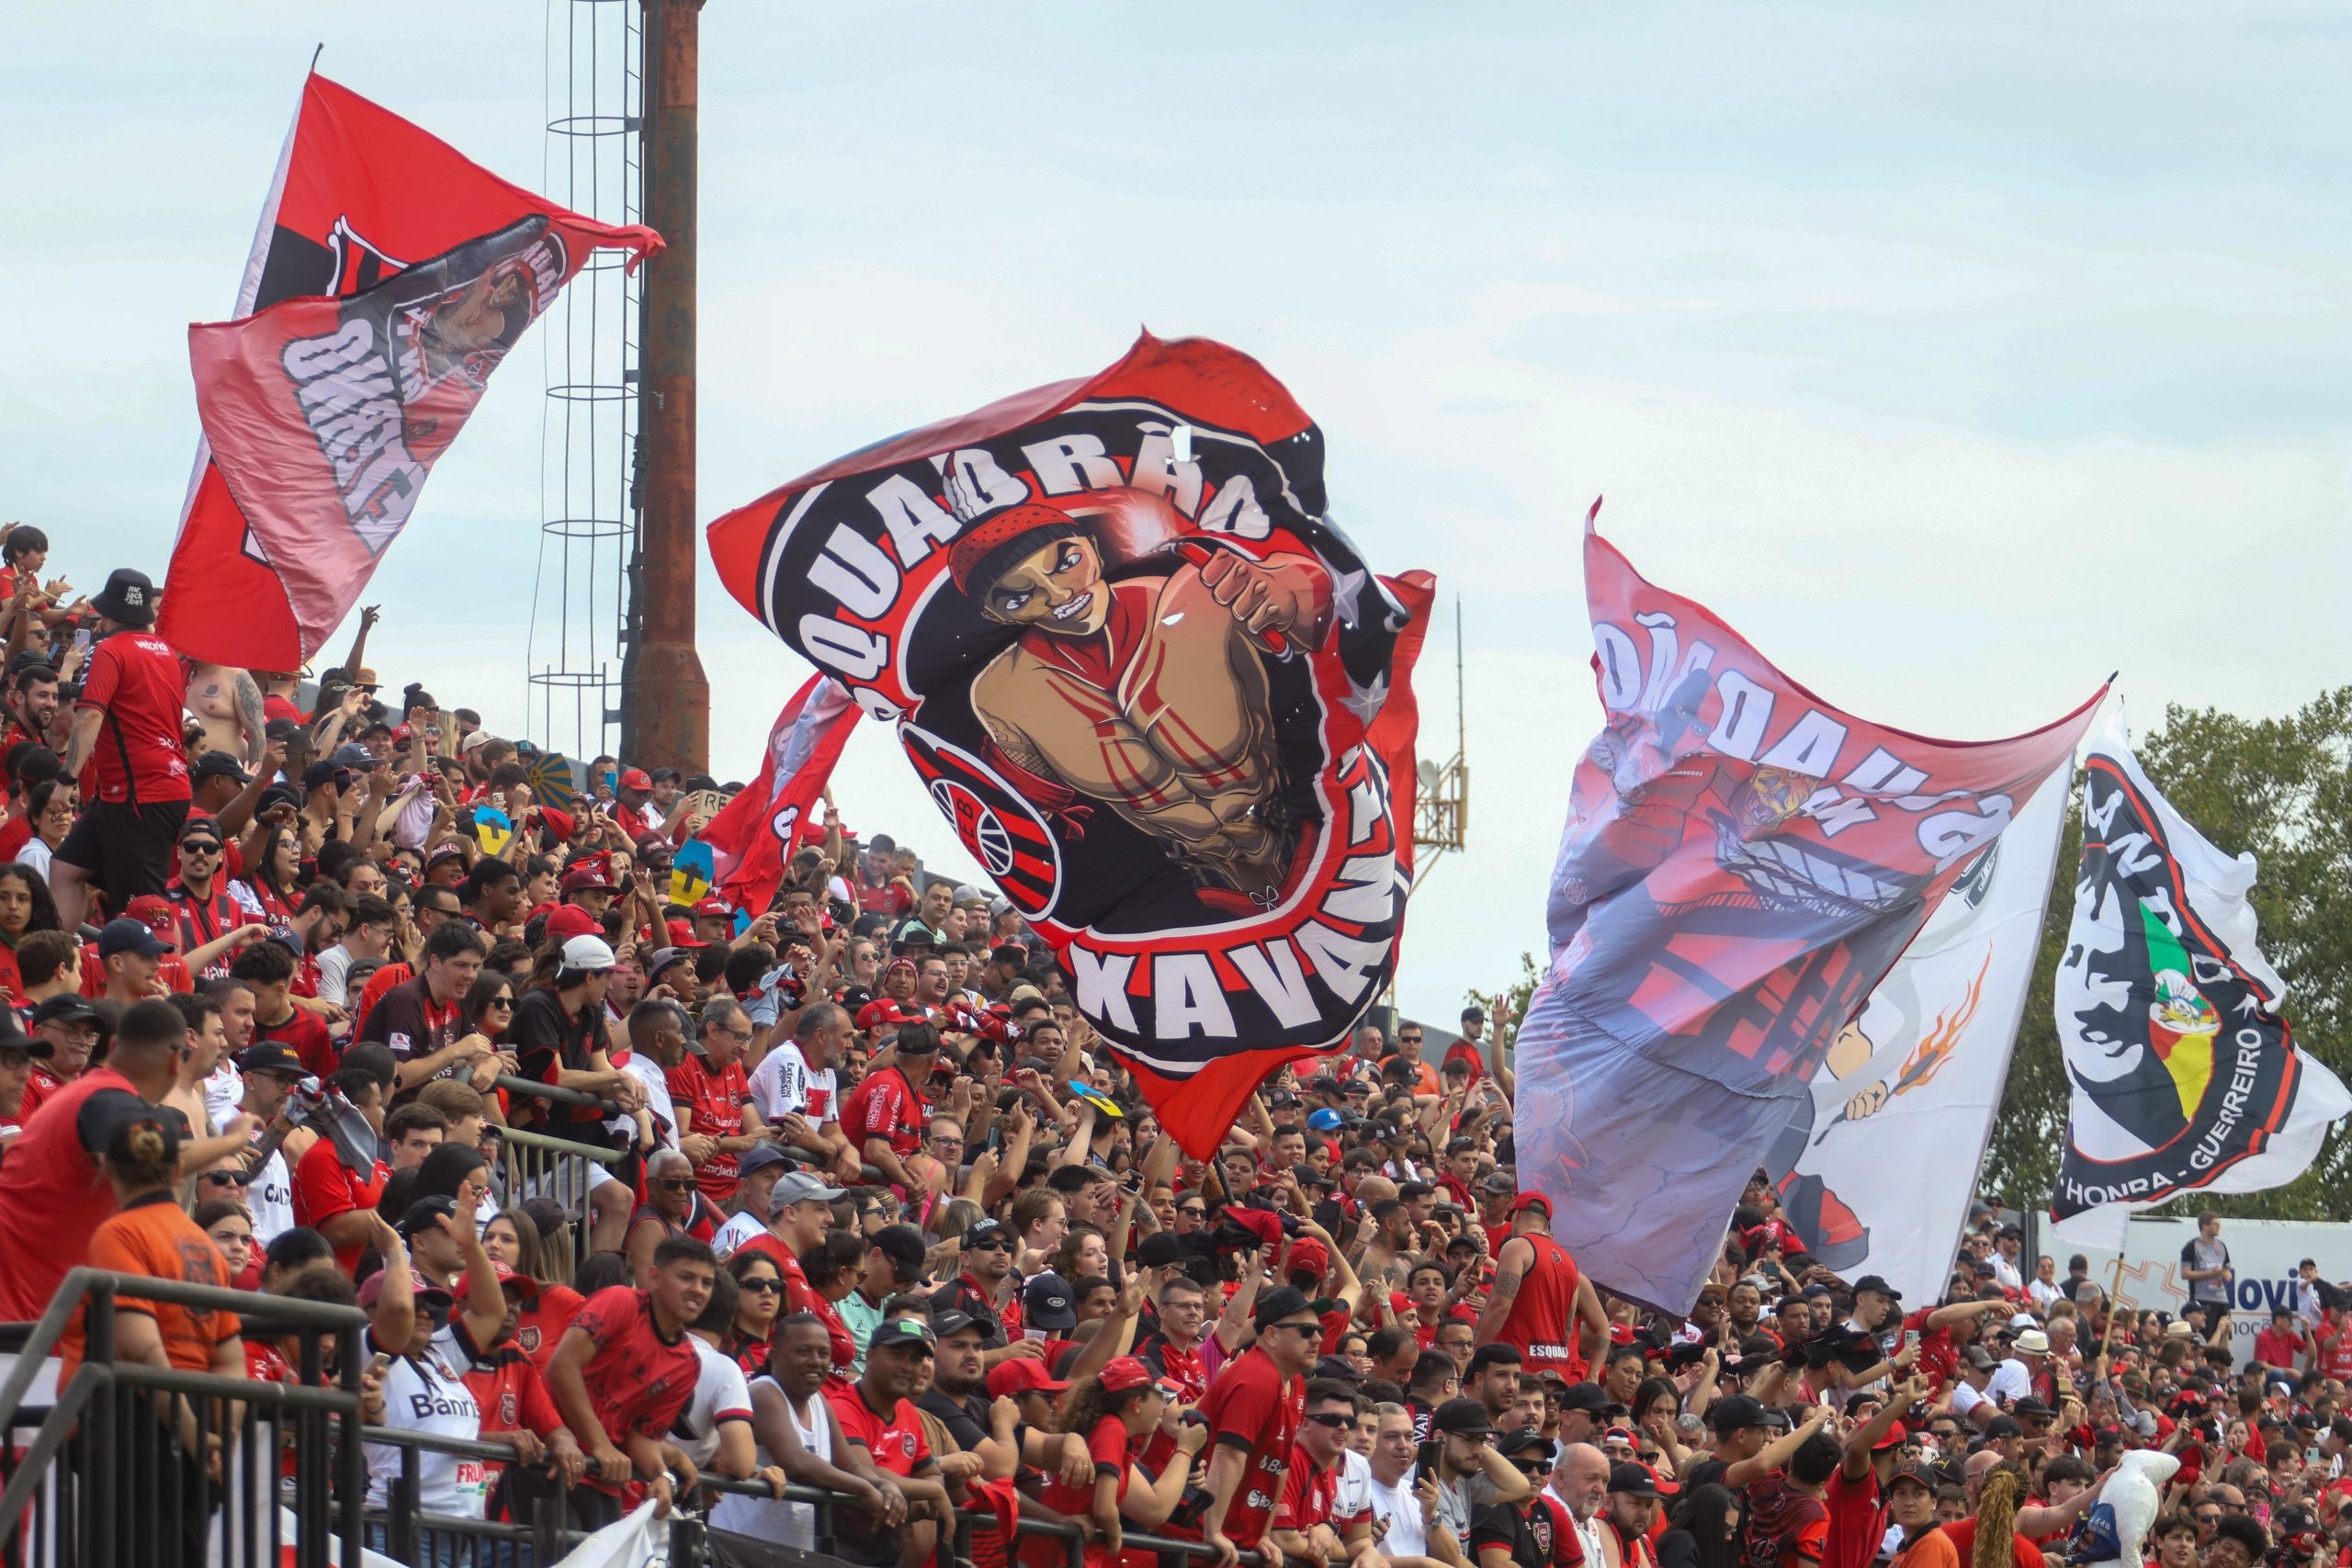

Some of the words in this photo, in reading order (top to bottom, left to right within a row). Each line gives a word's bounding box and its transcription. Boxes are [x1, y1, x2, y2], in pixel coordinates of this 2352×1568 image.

[786, 1062, 795, 1099] Extremo
[2066, 1171, 2174, 1207] HONRA
[2189, 1028, 2262, 1170] GUERREIRO
